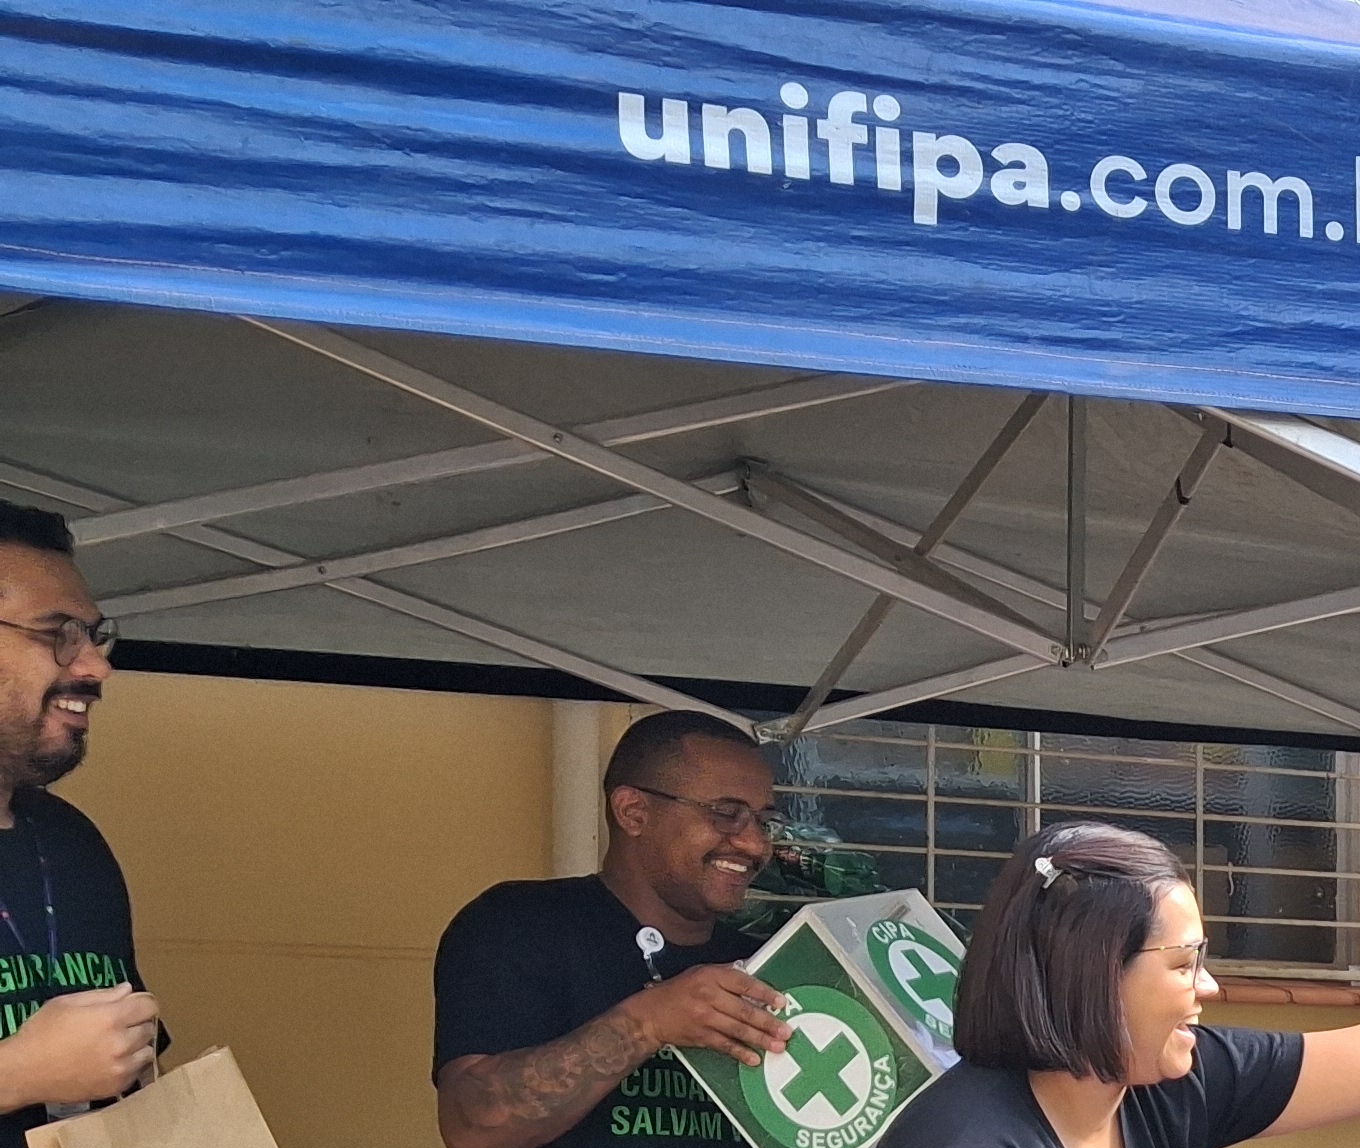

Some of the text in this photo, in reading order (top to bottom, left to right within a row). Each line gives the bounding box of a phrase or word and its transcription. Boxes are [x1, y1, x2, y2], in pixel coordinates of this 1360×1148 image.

[871, 920, 916, 945] CIPA
[619, 1068, 715, 1102] CUIDA
[611, 1105, 722, 1142] SALVAM
